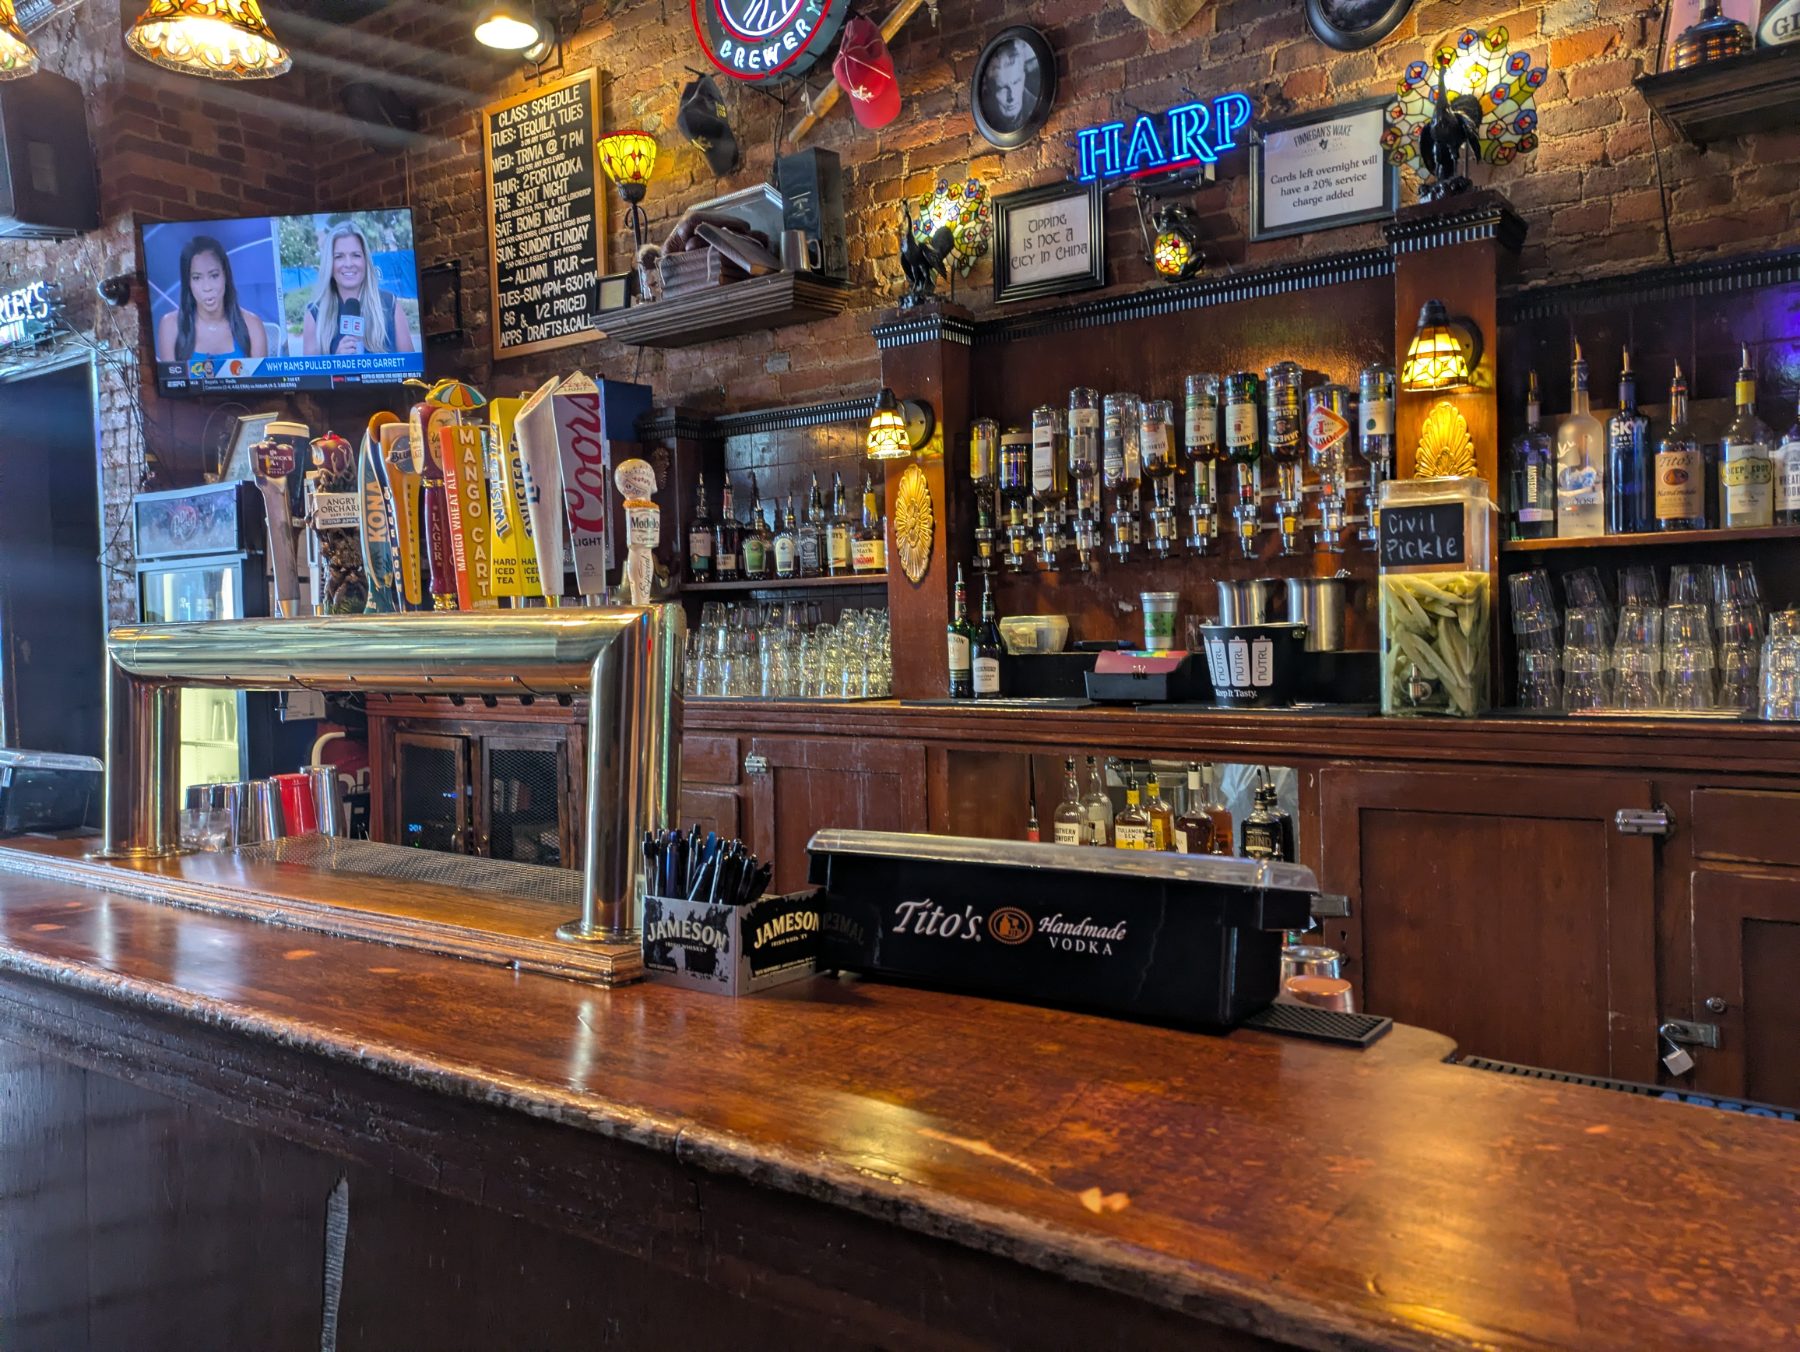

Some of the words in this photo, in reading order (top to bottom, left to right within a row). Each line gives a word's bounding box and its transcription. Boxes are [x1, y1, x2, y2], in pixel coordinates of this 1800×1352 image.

[498, 104, 529, 128] CLASS
[531, 84, 580, 116] SCHEDULE
[491, 127, 517, 148] TUES:
[517, 113, 557, 139] TEQUILA
[558, 103, 584, 126] TUES
[1077, 92, 1252, 182] HARP
[1293, 124, 1332, 148] FINNEGAN'S
[1332, 123, 1353, 137] WAKE
[492, 154, 515, 174] WED:
[515, 143, 545, 165] TRIVIA
[546, 139, 558, 155] @
[560, 134, 568, 151] 7
[569, 128, 584, 148] PM
[493, 177, 520, 198] THUR:
[552, 156, 584, 179] VODKA
[1270, 172, 1297, 185] Cards
[1299, 167, 1314, 180] left
[1316, 159, 1359, 177] overnight
[1361, 154, 1378, 166] will
[493, 195, 511, 215] FRI:
[516, 186, 540, 208] SHOT
[542, 177, 570, 200] NIGHT
[1280, 185, 1302, 197] have
[1303, 184, 1310, 193] a
[1312, 177, 1333, 191] 20%
[1335, 172, 1368, 186] service
[1292, 196, 1323, 208] charge
[1325, 187, 1354, 202] added
[495, 220, 513, 239] SAT:
[516, 211, 542, 233] BOMB
[544, 202, 572, 225] NIGHT
[496, 245, 517, 264] SUN:
[519, 233, 552, 257] SUNDAY
[554, 222, 590, 248] FUNDAY
[1023, 237, 1033, 252] IS
[1065, 227, 1074, 242] A
[1010, 254, 1036, 270] CITY
[1040, 250, 1051, 265] IN
[1055, 242, 1088, 261] CHINA
[514, 262, 549, 286] ALUMNI
[554, 254, 579, 277] HOUR
[503, 310, 516, 327] $6
[520, 313, 529, 329] &
[535, 302, 551, 321] 1/2
[553, 293, 587, 317] PRICED
[500, 329, 523, 348] APPS
[168, 366, 182, 374] SC
[265, 362, 283, 372] WHY
[283, 361, 304, 372] RAMS
[304, 360, 332, 371] PULLED
[333, 358, 356, 370] TRADE
[357, 358, 372, 369] FOR
[373, 357, 406, 368] GARRETT
[167, 380, 186, 388] ESPN
[1610, 416, 1649, 437] SKYY
[563, 392, 604, 534] Coors
[1659, 454, 1695, 468] Tito's
[446, 468, 459, 490] ALE
[1656, 487, 1698, 498] Handmade
[327, 497, 356, 506] ANGRY
[365, 481, 388, 543] KONA
[449, 493, 463, 531] WHEAT
[458, 428, 483, 518] MANGO
[471, 526, 490, 598] CART
[631, 516, 659, 529] Modelo
[1388, 512, 1436, 535] Civil
[383, 486, 397, 539] BLUE
[390, 546, 403, 594] MOON
[431, 512, 443, 562] LAGER
[574, 537, 602, 547] LIGHT
[1385, 535, 1459, 561] Pickle
[453, 535, 467, 572] MANGO
[493, 557, 518, 567] HARD
[521, 557, 538, 566] HAR
[494, 567, 515, 576] ICED
[496, 576, 515, 585] TEA
[1215, 647, 1226, 682] NUTRL
[1234, 647, 1245, 682] NUTRL
[1257, 646, 1269, 682] NUTRL
[1234, 689, 1258, 699] Tasty.
[647, 919, 728, 953] JAMESON
[753, 910, 820, 949] JAMESON
[1037, 912, 1128, 941] Handmade
[682, 943, 708, 954] WHISKEY
[770, 939, 786, 947] IRISH
[1049, 936, 1114, 956] VODKA
